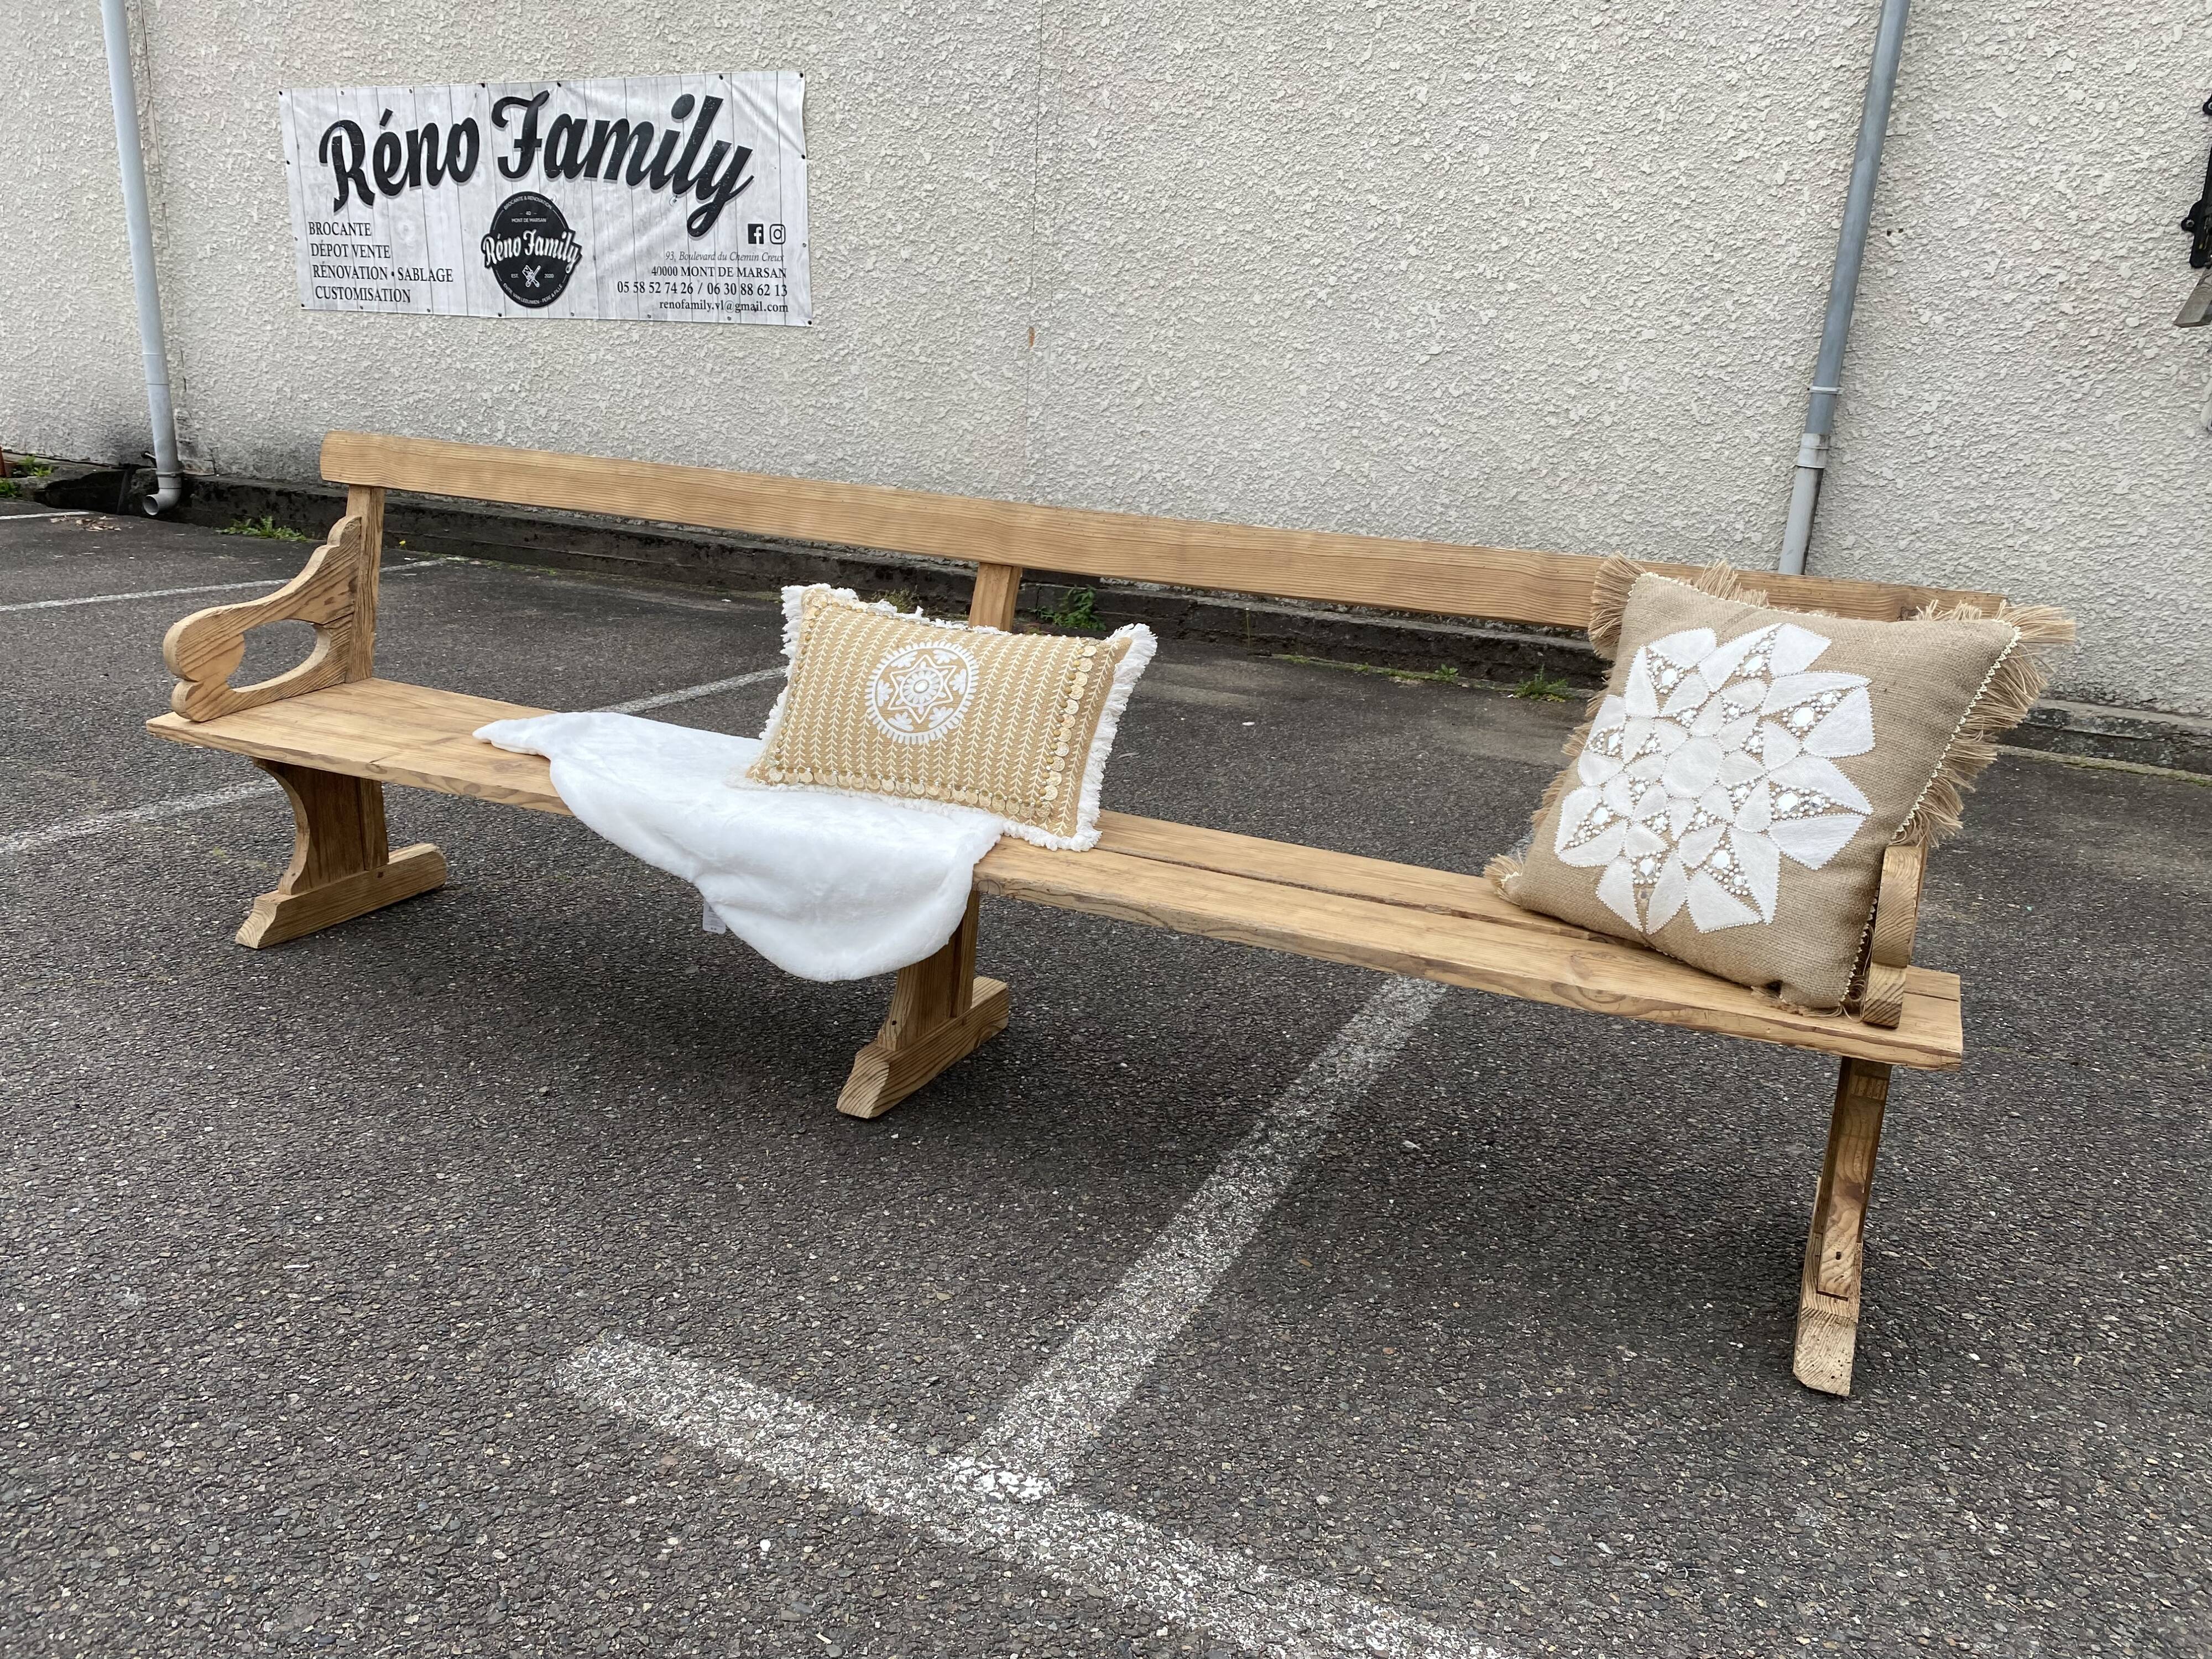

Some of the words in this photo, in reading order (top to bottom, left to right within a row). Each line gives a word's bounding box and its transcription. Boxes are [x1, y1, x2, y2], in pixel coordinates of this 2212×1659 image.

[319, 108, 479, 213] Réno
[492, 90, 754, 238] Family
[309, 222, 372, 236] BROCANTE
[310, 239, 348, 257] DÉPOT
[351, 244, 390, 258] VENTE
[483, 233, 521, 265] Réno
[523, 229, 580, 274] Family
[665, 251, 676, 262] 93,
[679, 251, 715, 261] Boulevard
[717, 252, 727, 261] du
[729, 252, 759, 262] Chemin
[761, 252, 784, 262] Creux
[312, 261, 388, 280] RÉNOVATION
[398, 267, 453, 282] SABLAGE
[651, 266, 678, 276] 40000
[681, 267, 715, 277] MONT
[718, 267, 734, 277] DE
[737, 267, 787, 278] MARSAN
[315, 286, 411, 302] CUSTOMISATION
[617, 281, 629, 293] 05
[633, 281, 645, 293] 58
[649, 281, 661, 294] 52
[664, 282, 677, 294] 74
[680, 282, 693, 294] 26
[707, 283, 721, 295] 06
[724, 283, 737, 295] 30
[740, 283, 753, 295] 88
[757, 284, 770, 296] 62
[775, 284, 787, 296] 13
[659, 299, 789, 313] renofamily.vl@gmail.com
